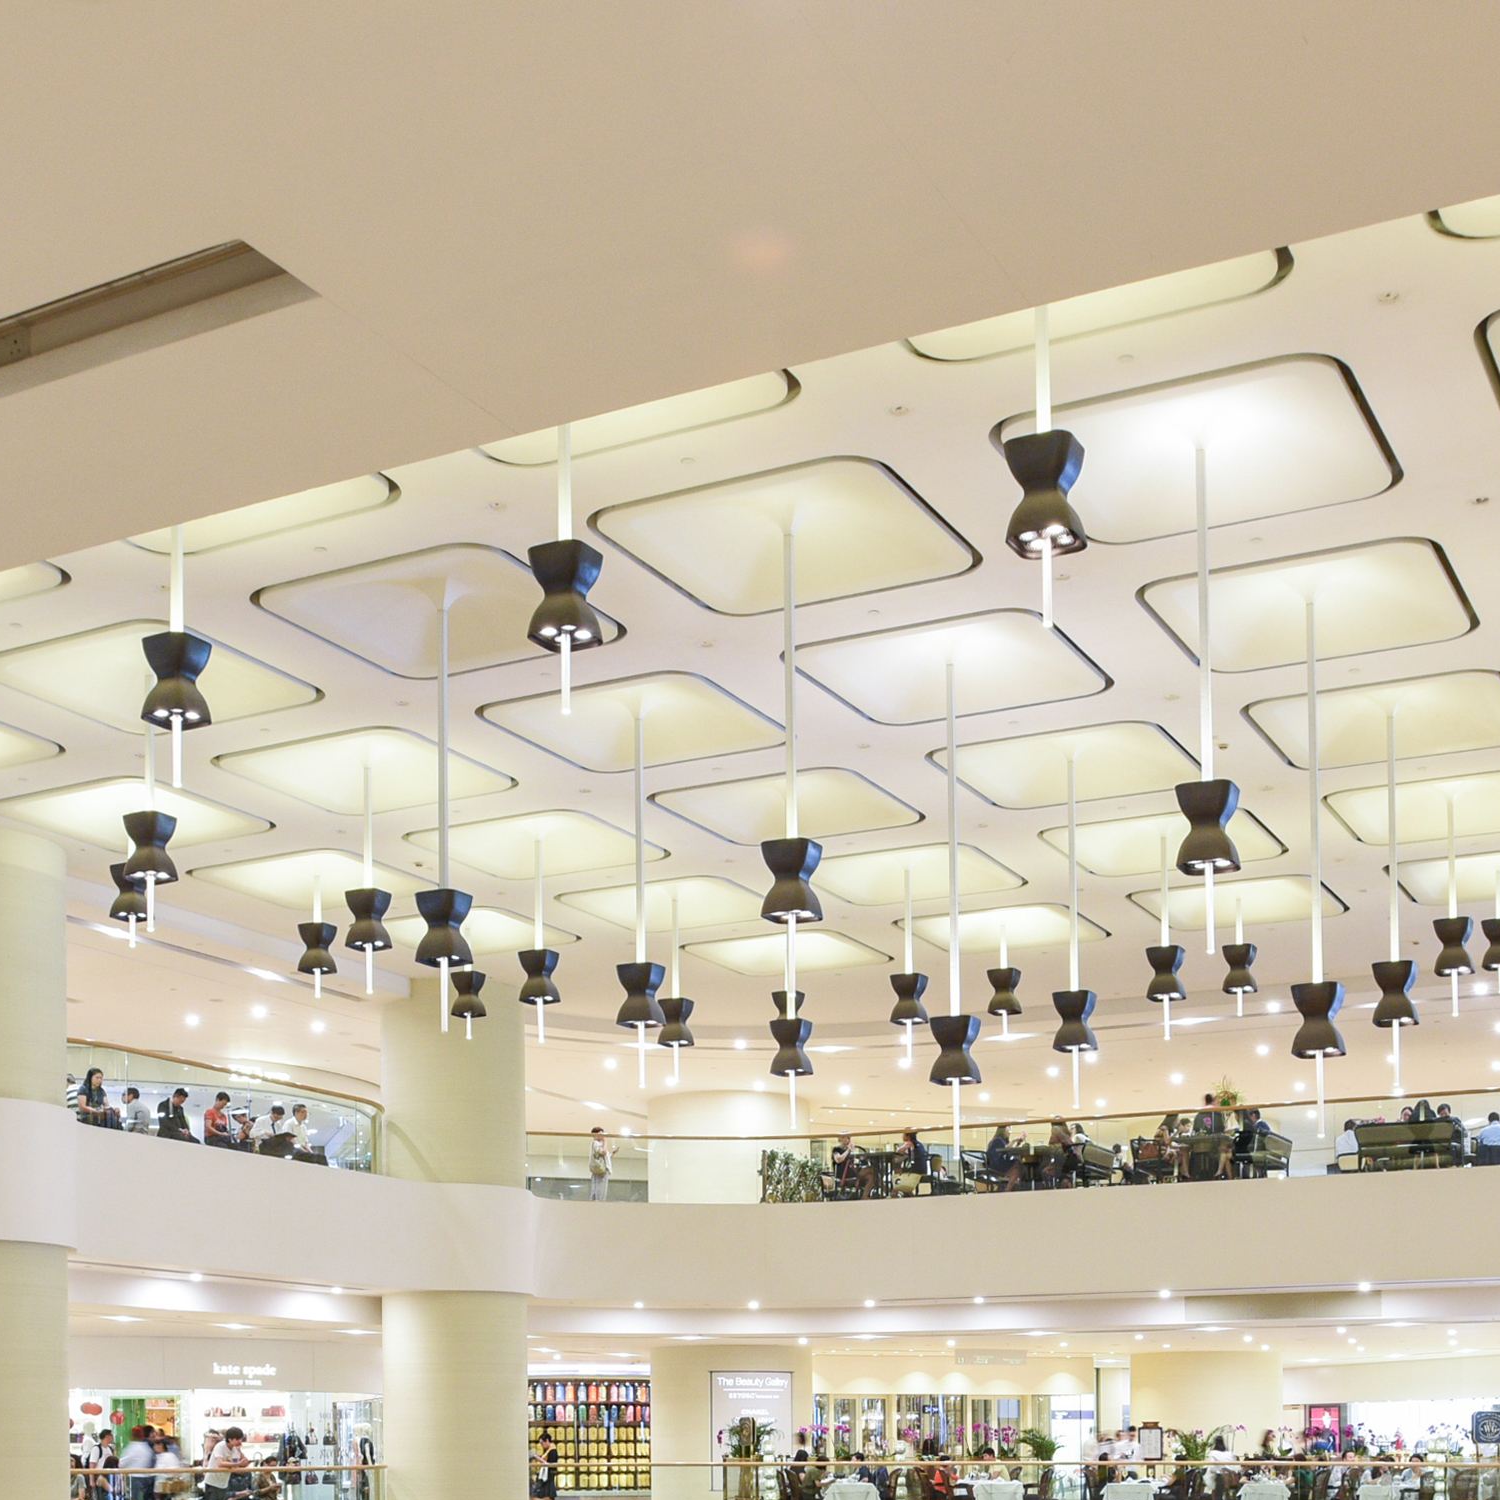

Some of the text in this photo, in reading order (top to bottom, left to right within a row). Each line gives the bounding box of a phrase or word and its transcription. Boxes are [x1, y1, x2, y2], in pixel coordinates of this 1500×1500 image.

[212, 1362, 276, 1379] kate spade
[716, 1376, 789, 1388] The Beauty Gallery
